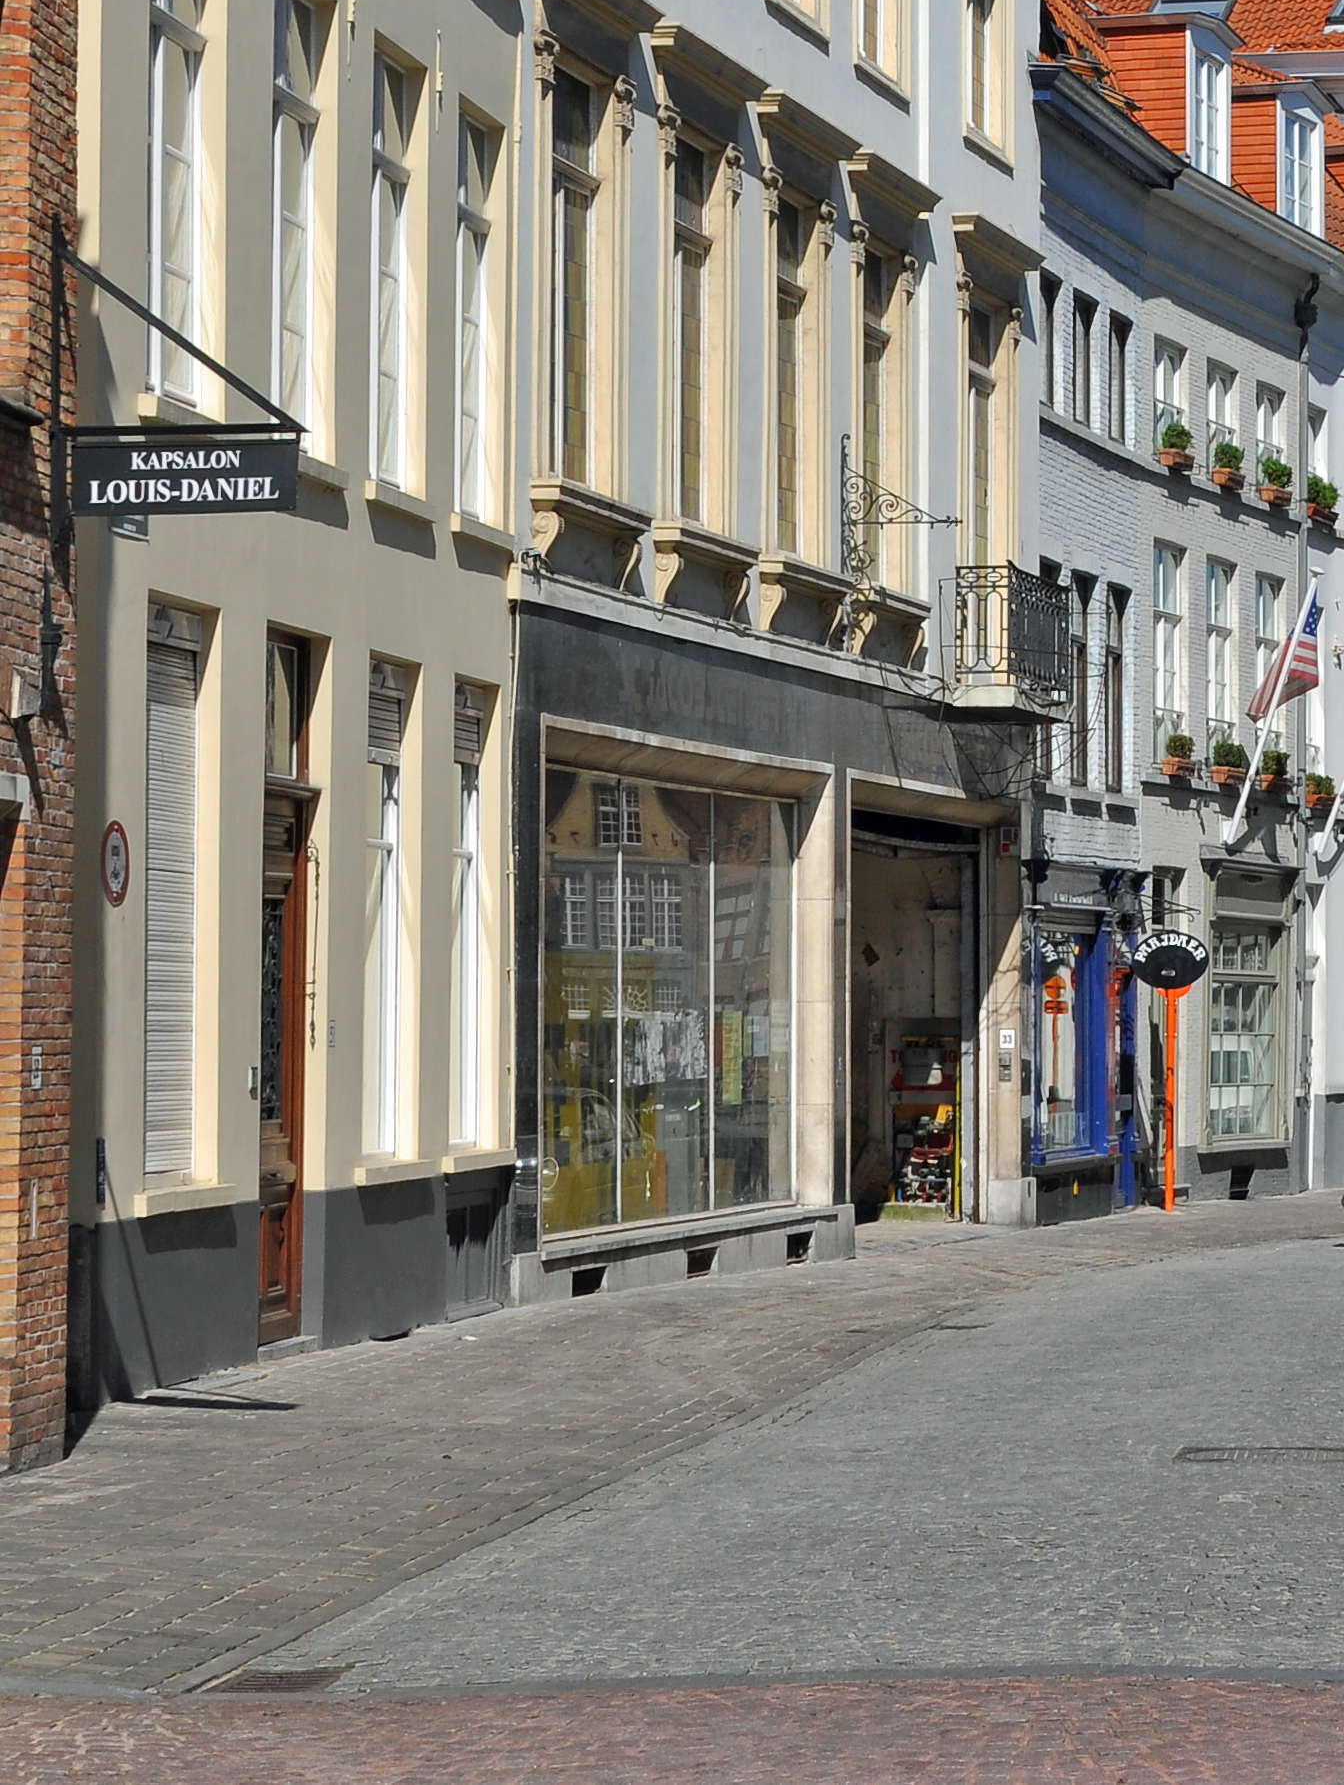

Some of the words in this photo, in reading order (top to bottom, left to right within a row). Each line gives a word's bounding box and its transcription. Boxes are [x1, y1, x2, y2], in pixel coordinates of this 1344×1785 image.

[130, 450, 241, 471] KAPSALON
[89, 476, 279, 504] LOUIS-DANIEL
[1001, 1034, 1012, 1044] 33
